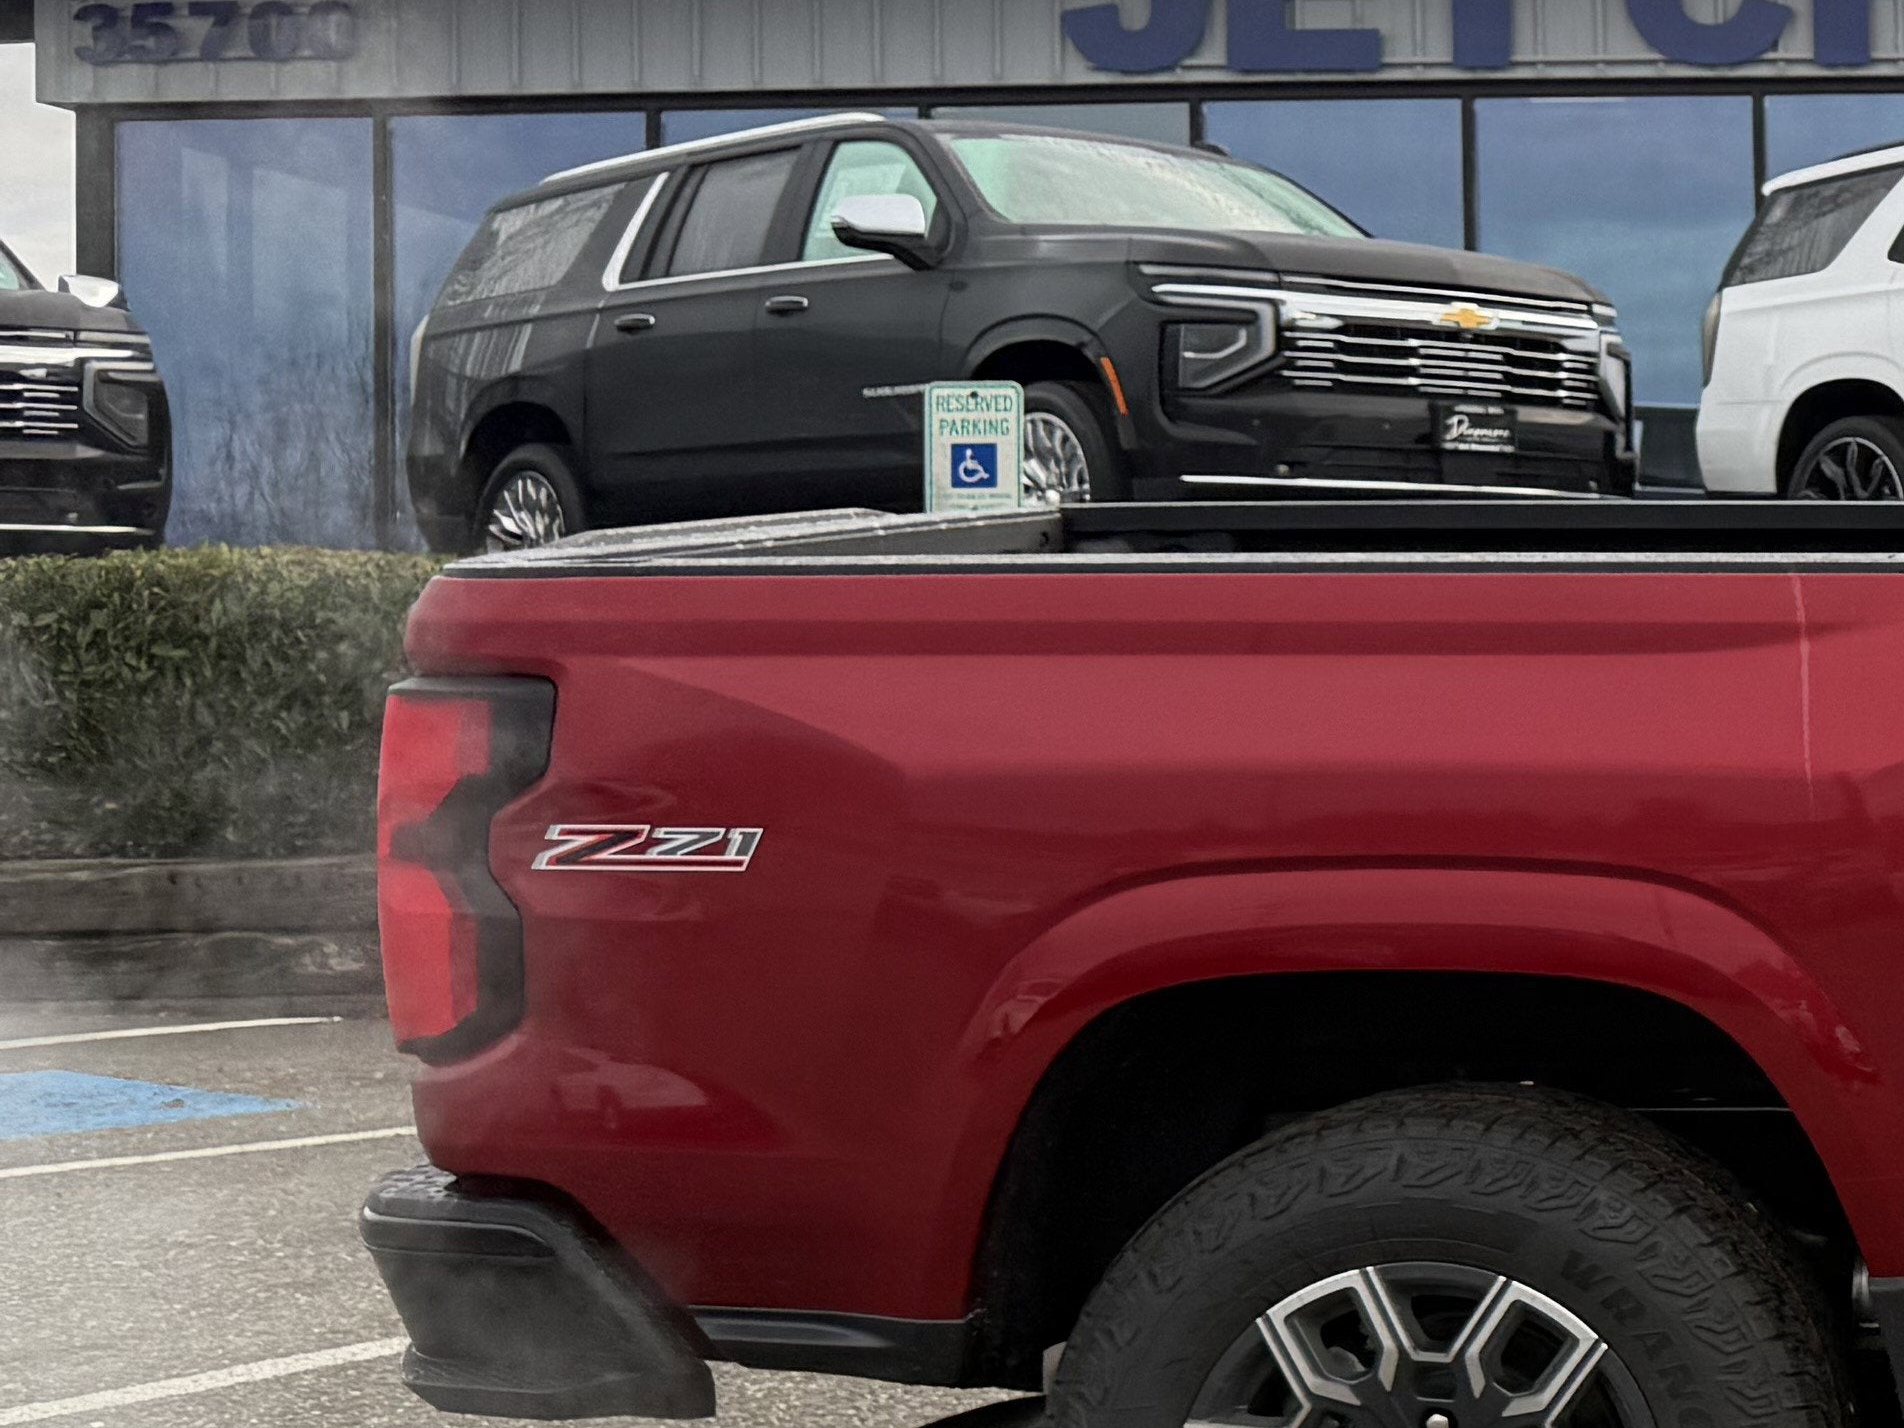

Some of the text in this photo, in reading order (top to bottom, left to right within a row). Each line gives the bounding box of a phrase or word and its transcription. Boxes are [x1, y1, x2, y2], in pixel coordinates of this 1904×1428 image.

[73, 0, 358, 66] 35700
[936, 394, 1013, 412] RESERVED
[940, 418, 1010, 436] PARKING
[531, 824, 763, 872] Z71
